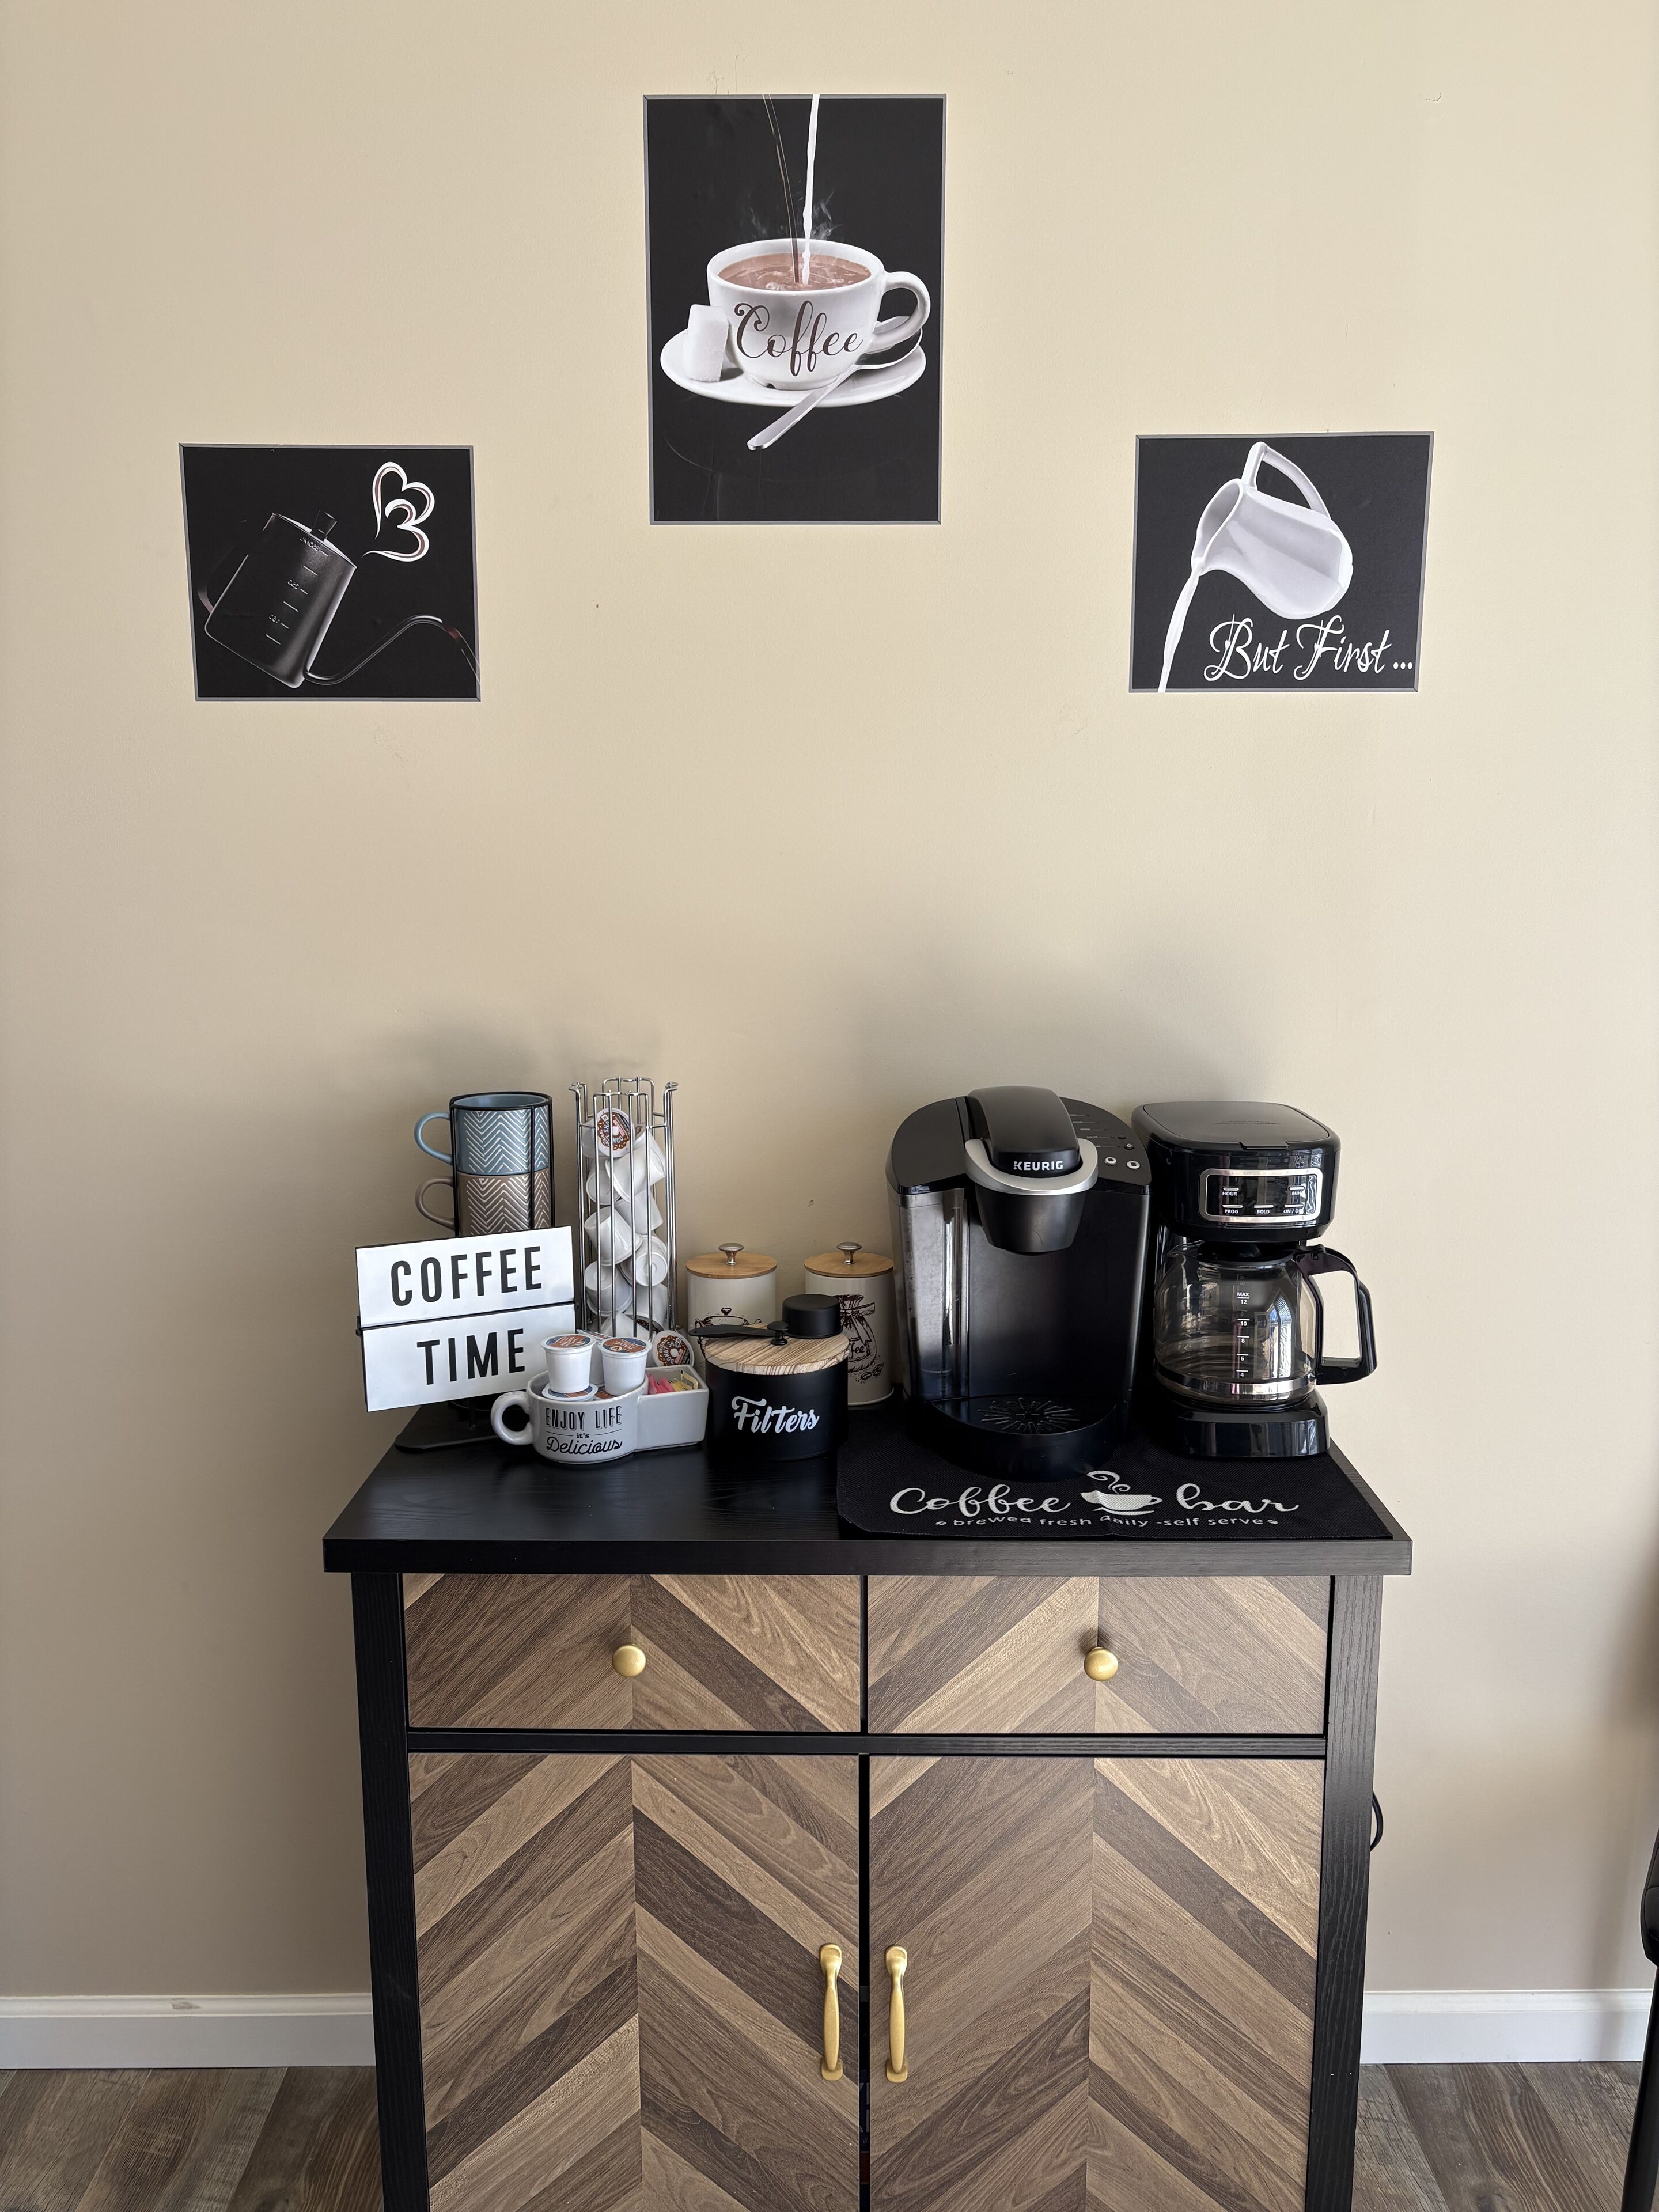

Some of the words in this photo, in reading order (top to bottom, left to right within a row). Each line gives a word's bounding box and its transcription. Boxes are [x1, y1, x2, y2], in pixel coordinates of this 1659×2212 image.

[733, 300, 863, 377] Coffee
[1203, 613, 1290, 681] But
[1013, 1160, 1064, 1171] KEURIG
[391, 1245, 543, 1306] COFFEE
[416, 1328, 525, 1385] TIME
[667, 1340, 681, 1349] SHOP
[546, 1407, 585, 1431] ENJOY
[595, 1406, 622, 1429] LIFE
[731, 1396, 820, 1434] Filters
[546, 1436, 623, 1455] Delicious
[889, 1484, 1071, 1517] Coffee
[1176, 1483, 1299, 1513] bar
[953, 1516, 1032, 1526] brewed
[1100, 1515, 1149, 1527] daily
